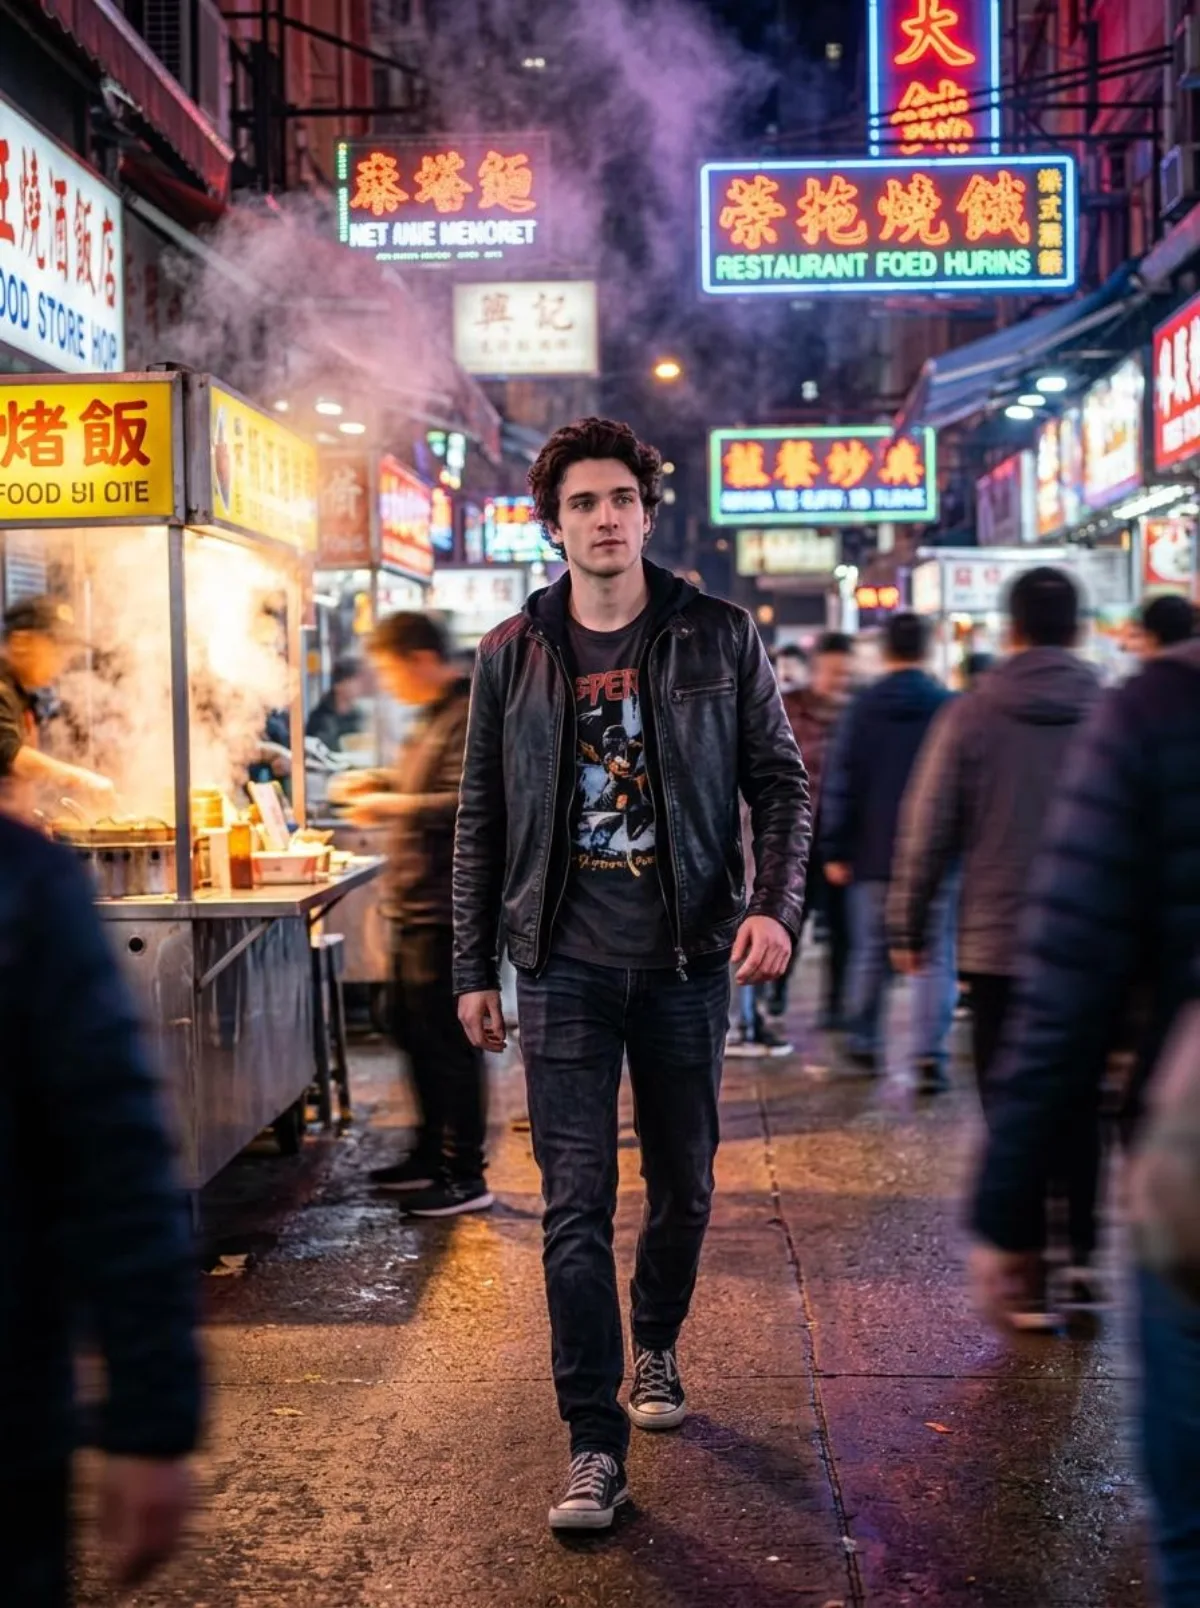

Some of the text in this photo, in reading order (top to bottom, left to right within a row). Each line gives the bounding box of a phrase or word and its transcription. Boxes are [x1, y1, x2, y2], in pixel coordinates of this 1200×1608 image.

[715, 252, 868, 280] RESTAURANT
[38, 291, 84, 360] STORE
[0, 398, 151, 468] 烤飯
